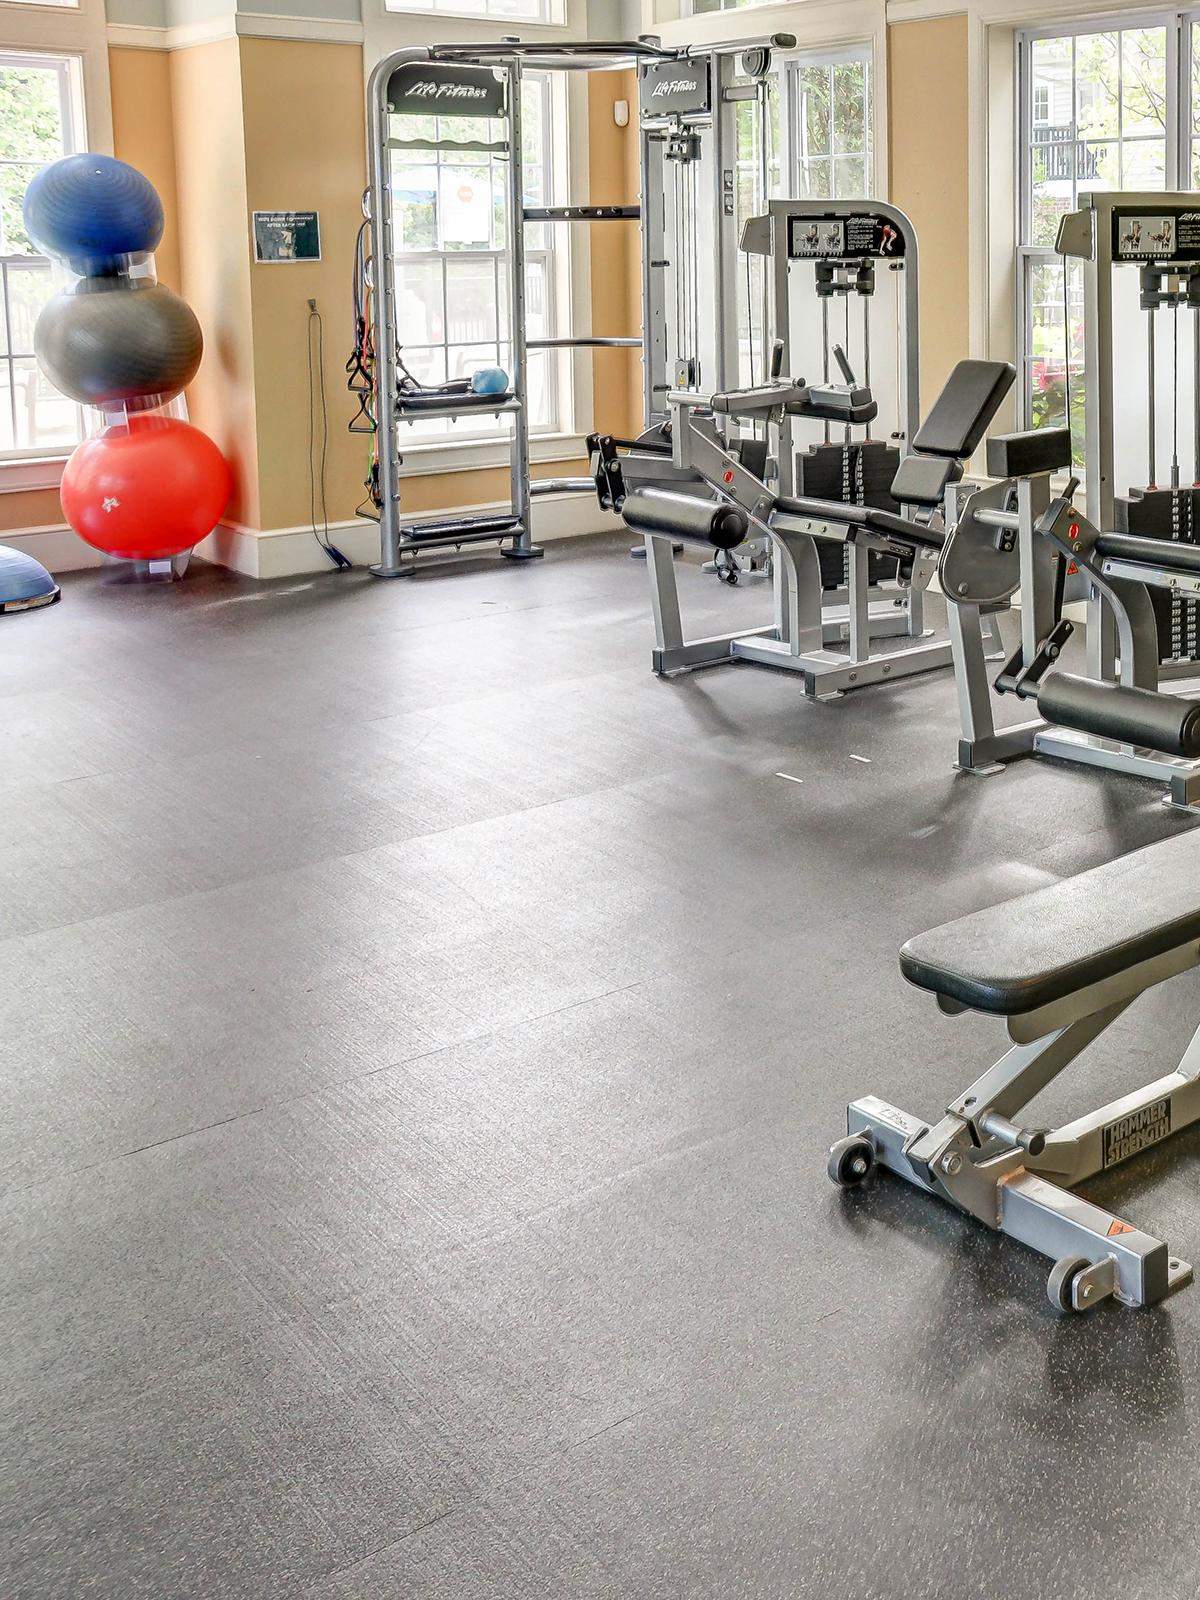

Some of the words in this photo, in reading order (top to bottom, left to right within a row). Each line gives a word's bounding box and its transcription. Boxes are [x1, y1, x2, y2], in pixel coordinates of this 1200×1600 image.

[435, 82, 488, 99] Fitness
[1107, 1116, 1170, 1166] STRENGTH
[1109, 1100, 1167, 1147] HAMMER
